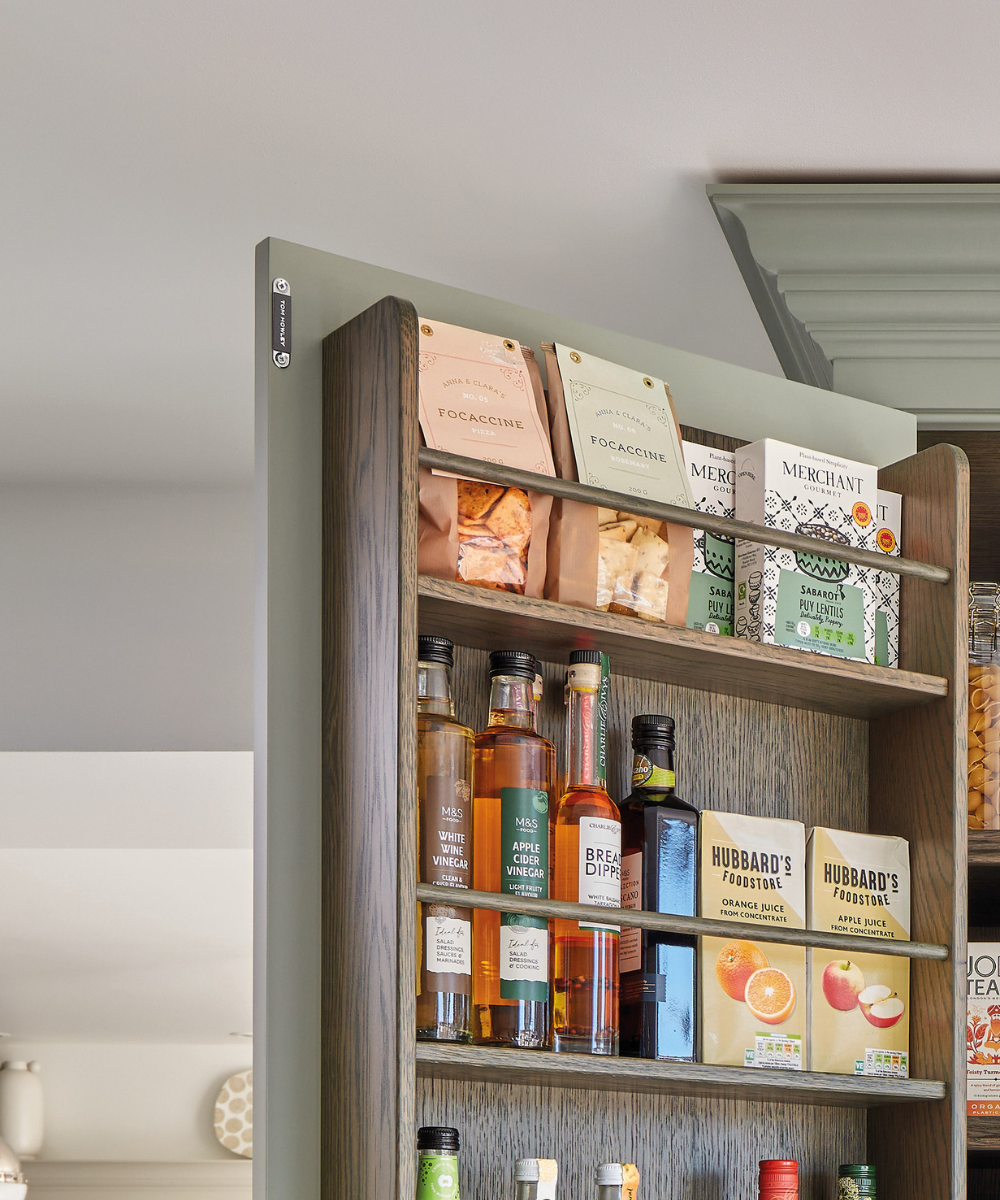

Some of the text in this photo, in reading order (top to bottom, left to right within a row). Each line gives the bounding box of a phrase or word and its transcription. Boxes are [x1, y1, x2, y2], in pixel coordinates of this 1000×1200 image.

[442, 378, 464, 388] ANNA
[438, 408, 524, 430] FOCACCINE
[595, 408, 614, 418] ANNA
[471, 428, 496, 436] PIZZA
[590, 435, 666, 463] FOCACCINE
[691, 463, 736, 486] MERC
[782, 461, 864, 494] MERCHANT
[804, 484, 842, 498] GOURMET
[800, 585, 840, 600] SABAROT
[708, 600, 724, 612] PUY
[800, 598, 844, 618] PUY LENTILS
[441, 806, 464, 818] M&S
[515, 816, 538, 829] M&S
[438, 830, 466, 844] WHITE
[440, 844, 464, 856] WINE
[512, 841, 541, 854] APPLE
[432, 856, 469, 870] VINEGAR
[513, 854, 540, 866] CIDER
[712, 845, 791, 876] HUBBARD'S
[507, 866, 545, 879] VINEGAR
[586, 862, 621, 881] DIPPE
[824, 862, 899, 892] HUBBARD'S
[722, 870, 782, 890] FOODSTORE
[509, 884, 525, 892] LIGHT
[833, 886, 890, 906] FOODSTORE
[722, 898, 784, 913] ORANGE JUICE
[720, 909, 787, 923] FROM CONCENTRATE
[838, 914, 887, 928] APPLE JUICE
[831, 924, 895, 938] FROM CONCENTRATE
[967, 979, 999, 995] TEA
